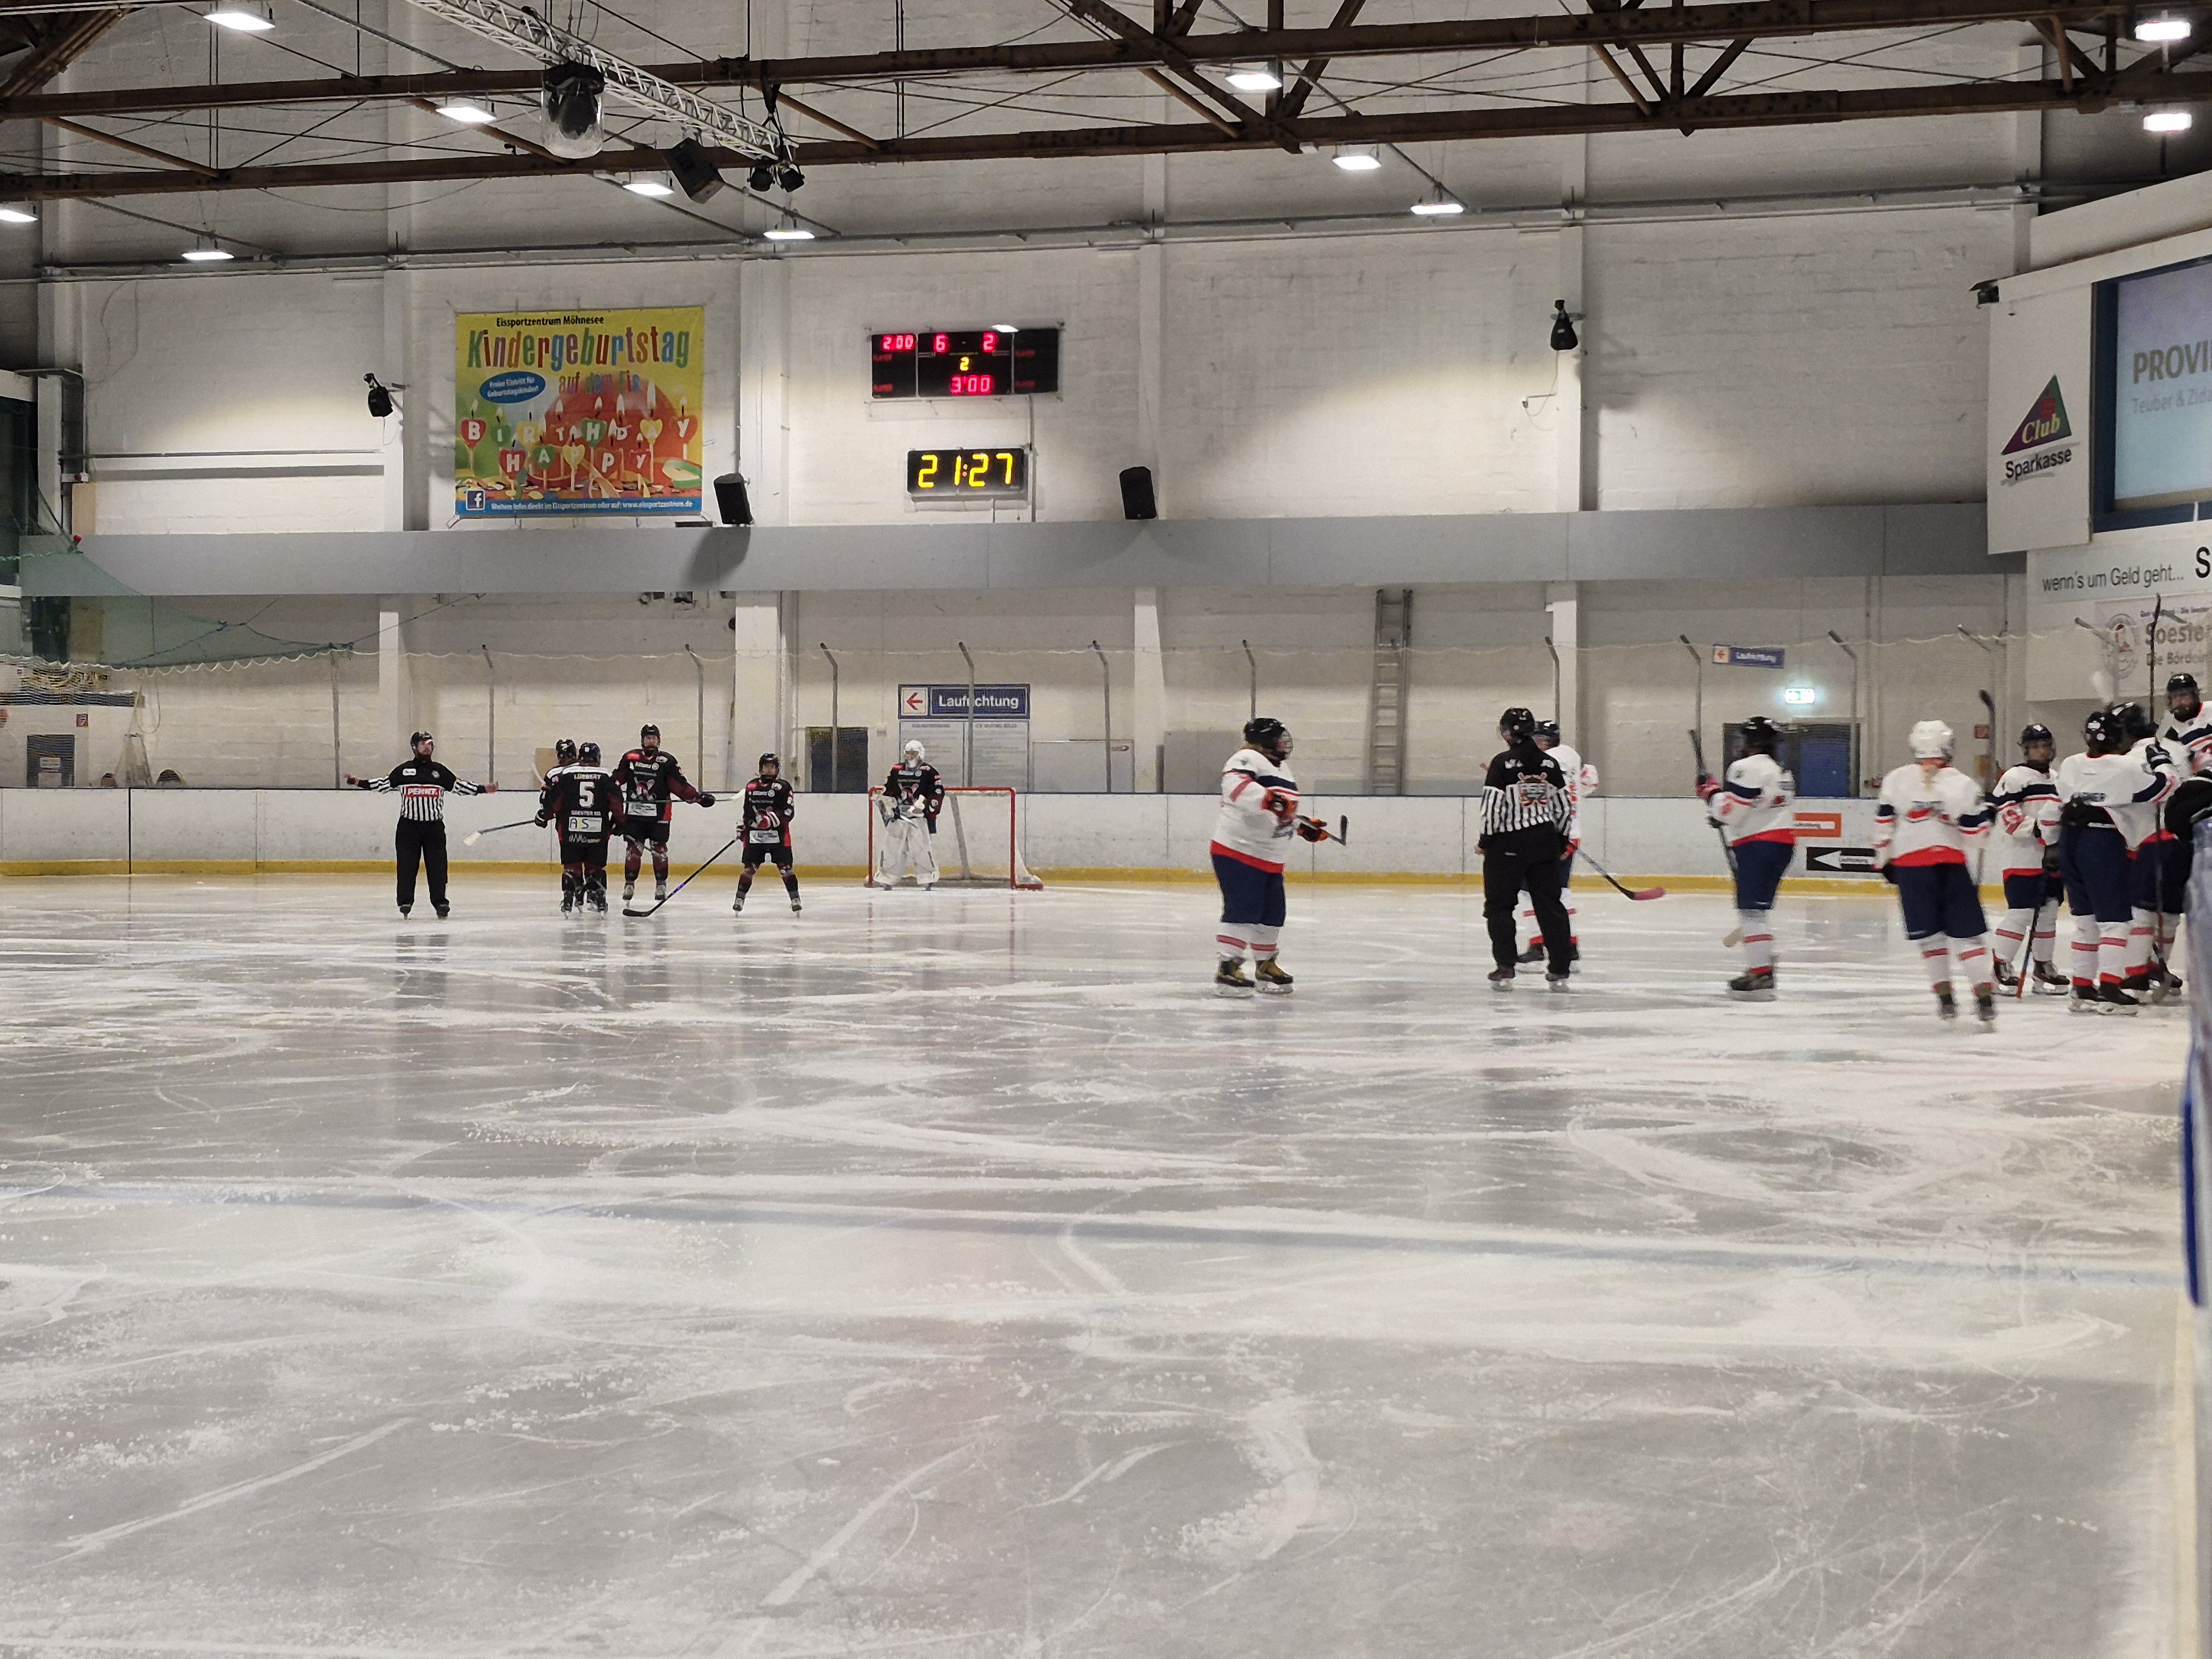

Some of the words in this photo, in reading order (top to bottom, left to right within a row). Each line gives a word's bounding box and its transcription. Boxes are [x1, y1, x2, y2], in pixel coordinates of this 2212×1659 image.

[496, 317, 561, 328] Eissportzentrum
[562, 315, 604, 325] Möhnesee
[467, 326, 690, 372] Kindergeburtstag
[935, 334, 948, 352] 6
[983, 332, 997, 352] 2
[959, 356, 970, 372] 2
[2132, 338, 2212, 384] PROVI
[558, 371, 581, 395] auf
[2021, 411, 2062, 445] Club
[917, 452, 1014, 488] 21:27
[2005, 448, 2072, 481] Sparkasse
[2088, 573, 2106, 588] um
[2110, 566, 2140, 586] Geld
[938, 694, 1019, 709] Laufrchtung
[579, 781, 595, 808] 5
